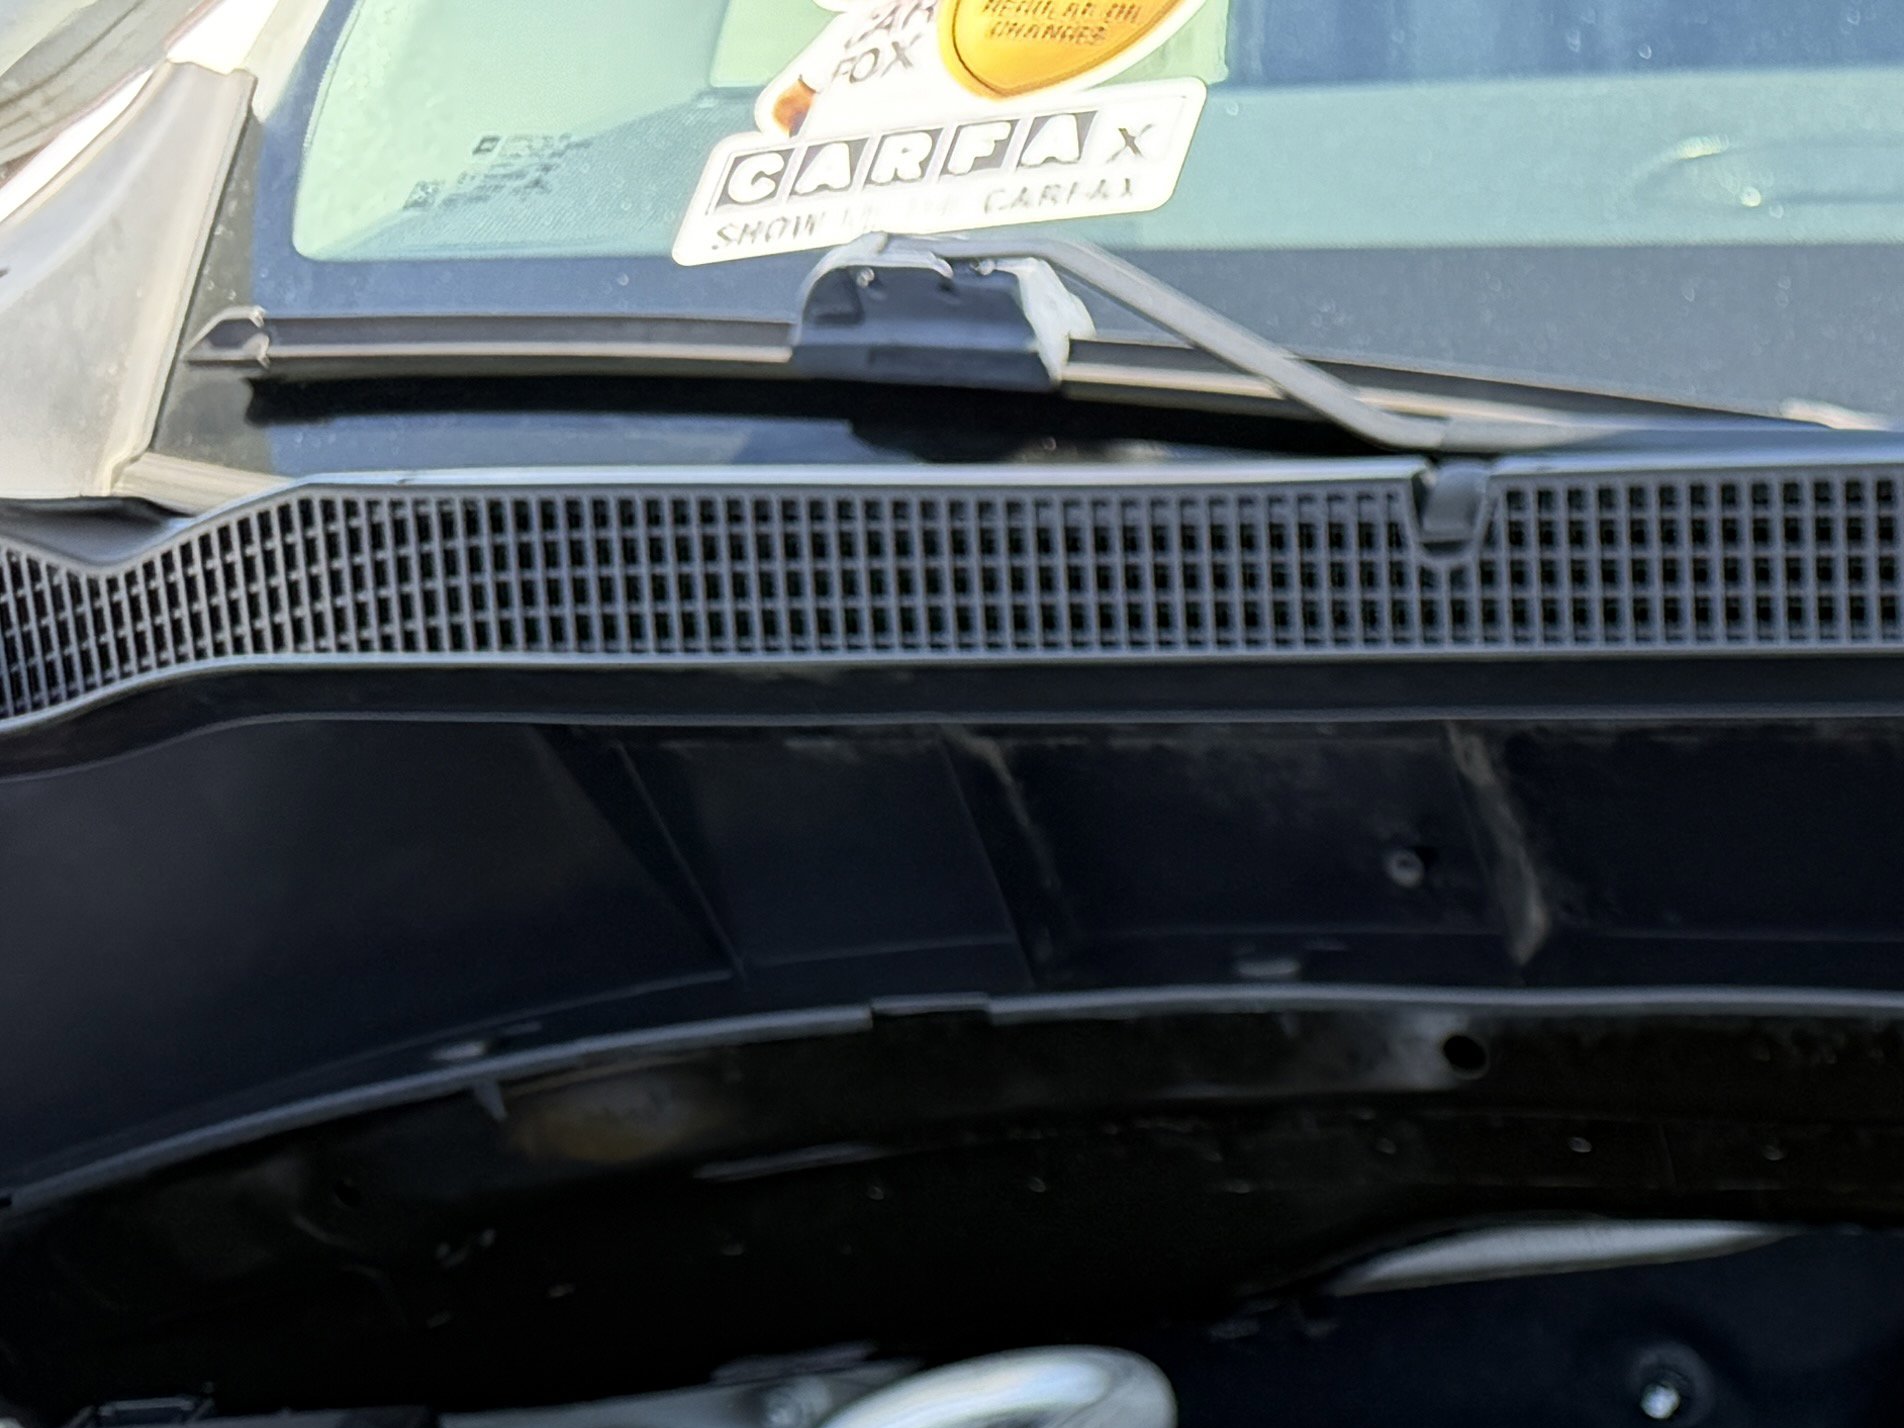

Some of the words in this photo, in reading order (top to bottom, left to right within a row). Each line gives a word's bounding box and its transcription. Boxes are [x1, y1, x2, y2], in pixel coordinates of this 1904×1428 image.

[831, 33, 923, 84] FOX
[722, 112, 1157, 206] CARFAX
[712, 213, 829, 251] SHOW
